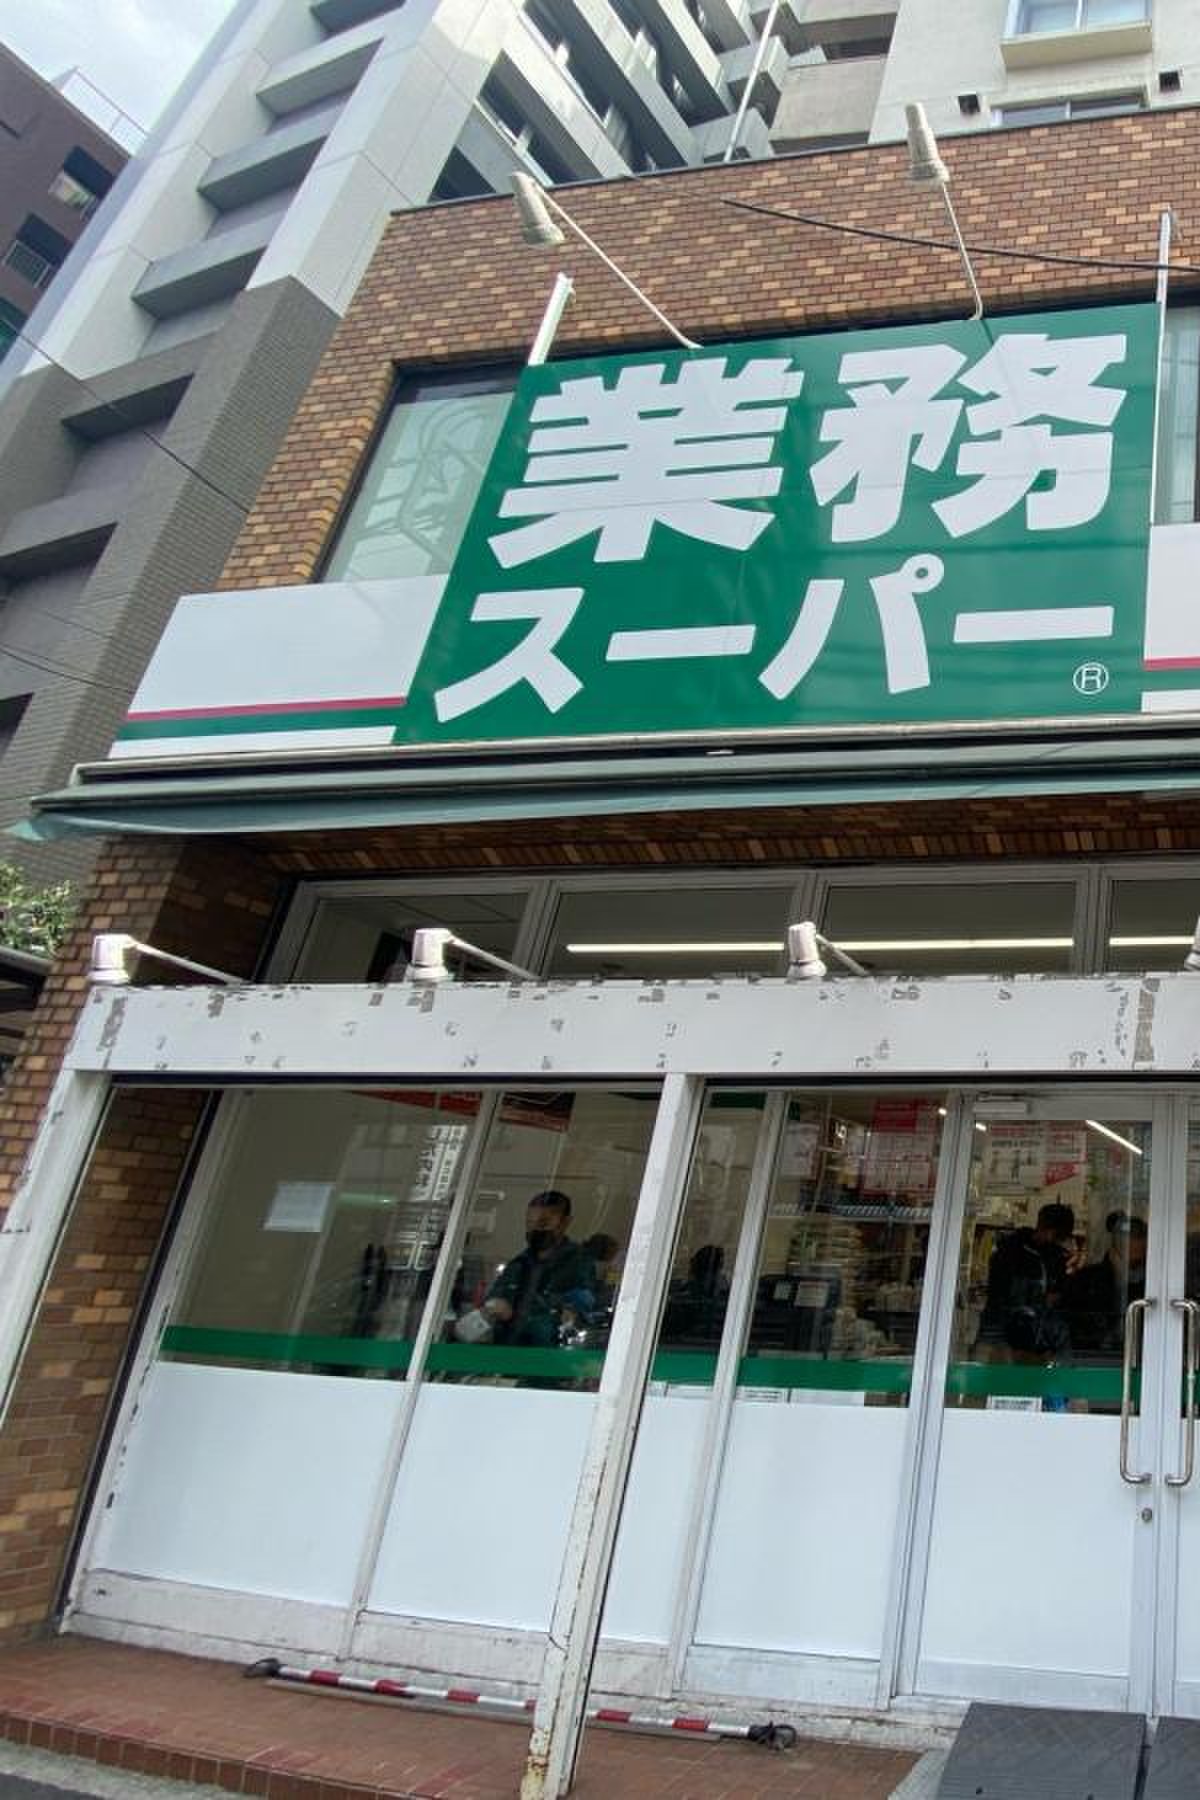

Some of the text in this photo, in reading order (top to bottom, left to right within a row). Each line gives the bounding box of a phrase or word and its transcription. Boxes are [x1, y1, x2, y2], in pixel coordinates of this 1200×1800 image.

[487, 334, 1127, 569] 業務
[434, 554, 1115, 723] スーパー
